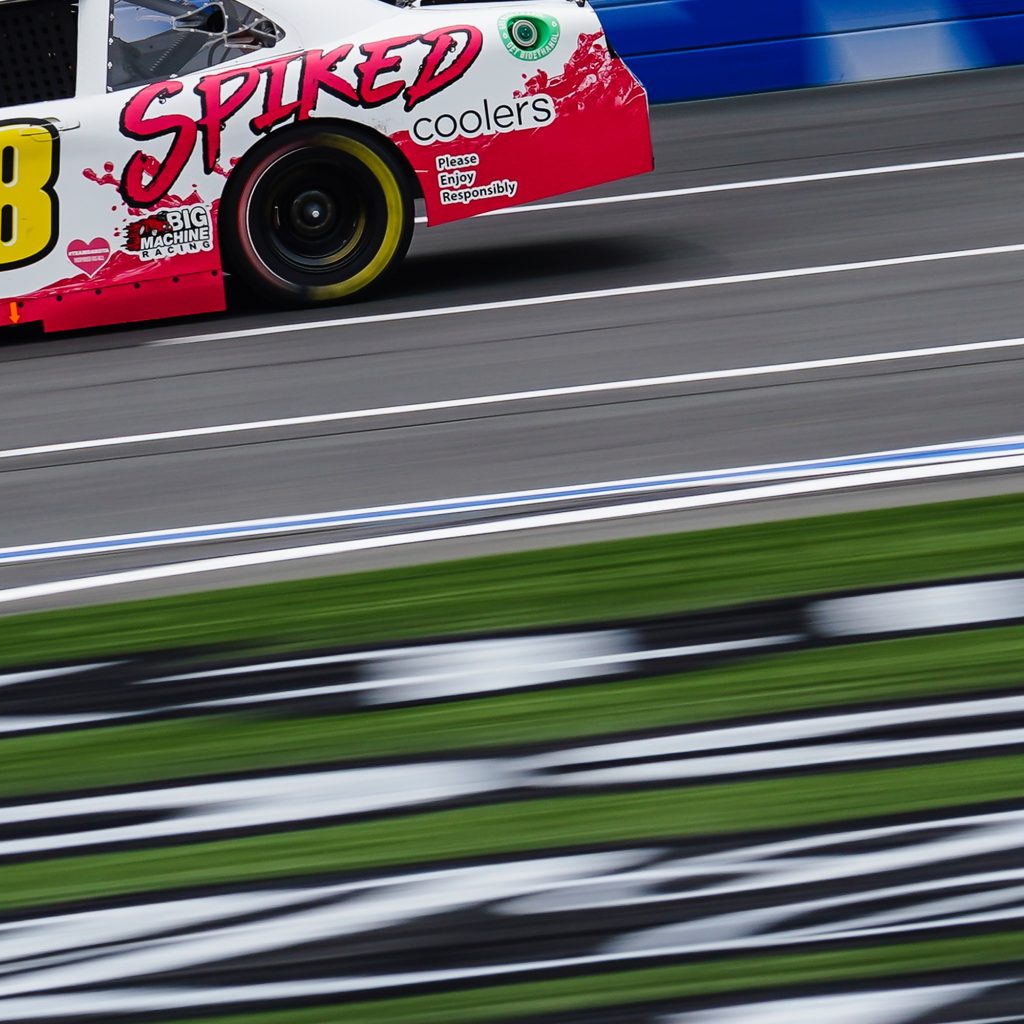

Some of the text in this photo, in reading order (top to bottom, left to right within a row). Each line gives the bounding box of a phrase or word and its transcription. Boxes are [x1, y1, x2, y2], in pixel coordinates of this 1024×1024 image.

[119, 24, 484, 208] SPIKED
[412, 98, 552, 142] coolers
[438, 154, 477, 170] Please
[440, 172, 474, 187] Enjoy
[442, 182, 516, 203] Responsibly
[166, 206, 209, 232] BIG
[140, 227, 210, 251] MACHINE
[141, 240, 211, 258] RACING
